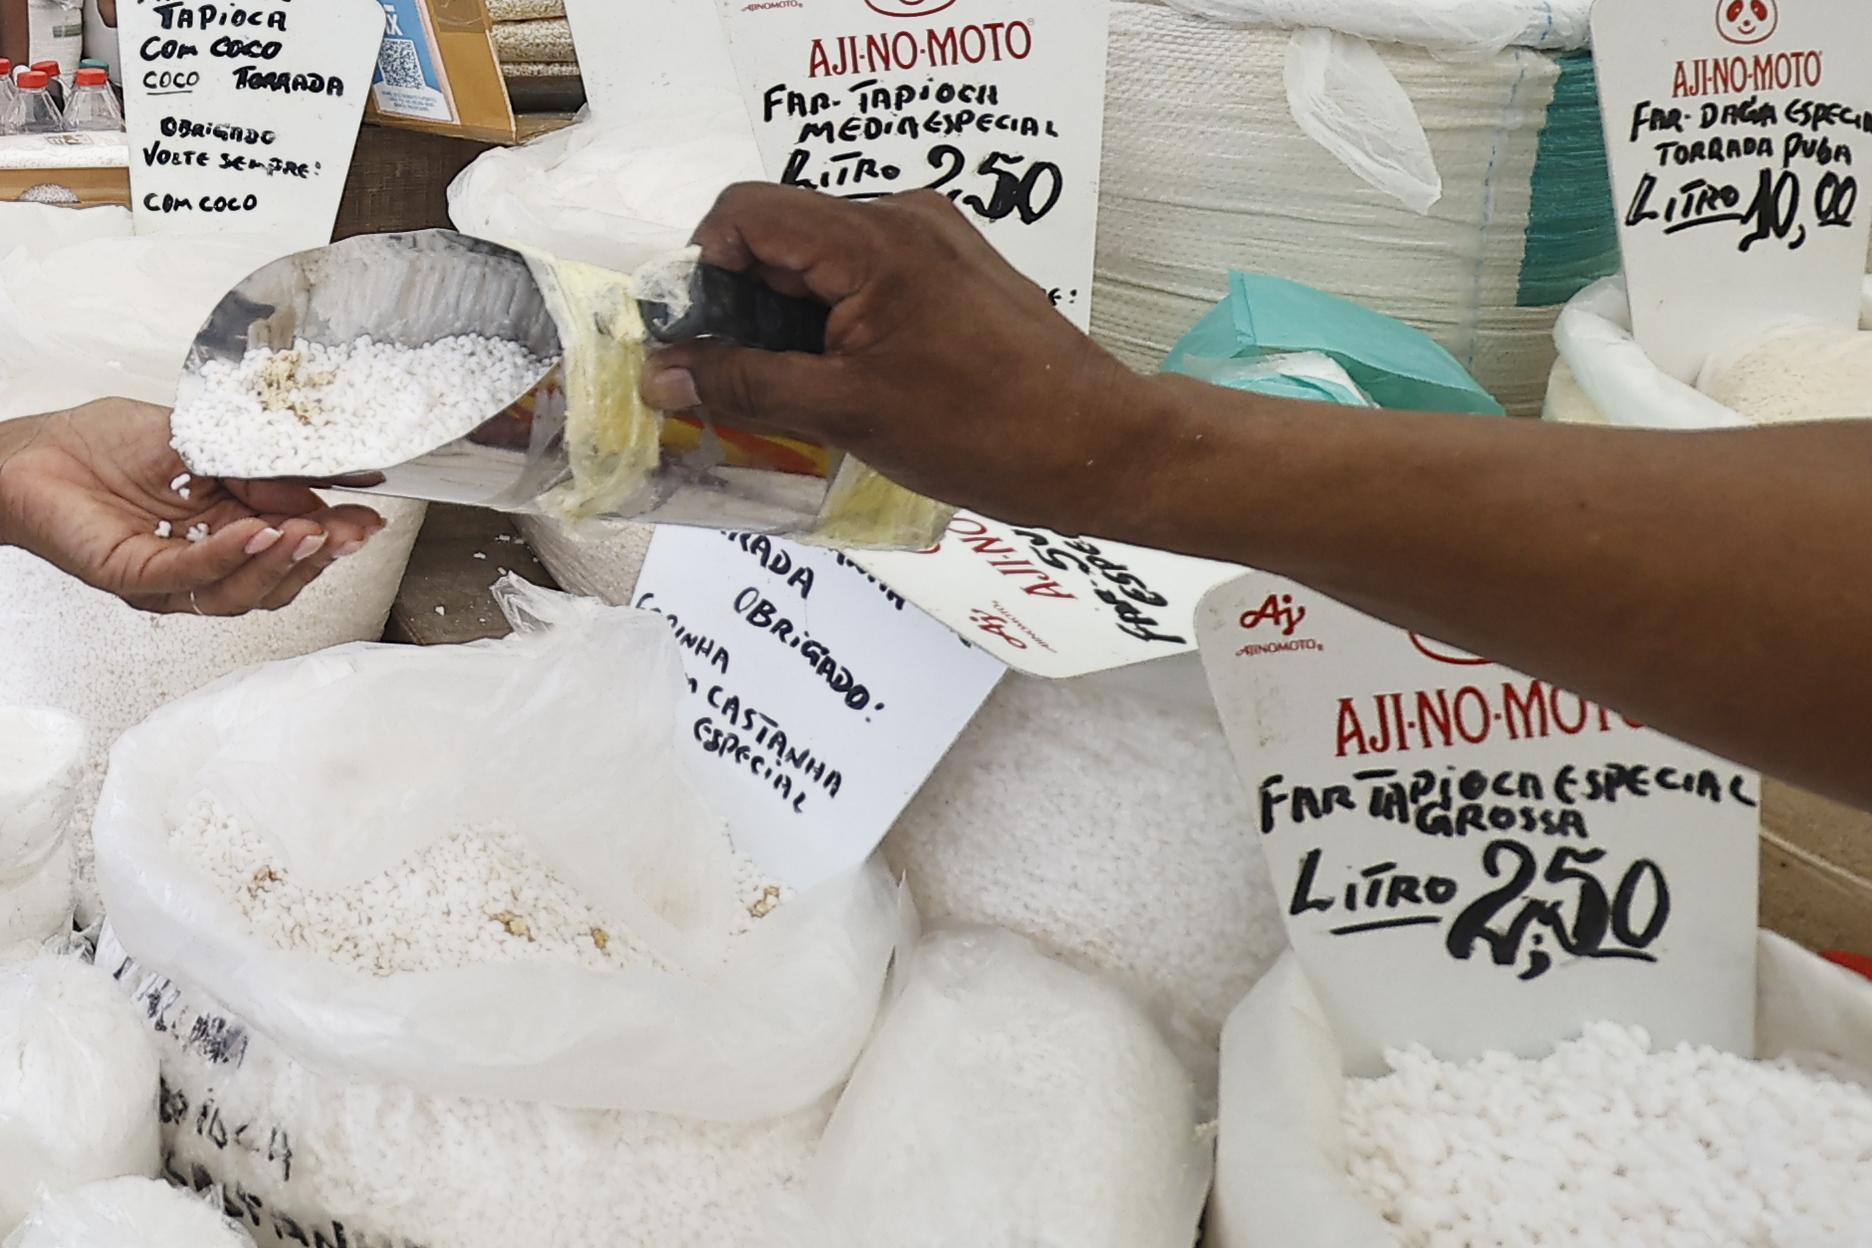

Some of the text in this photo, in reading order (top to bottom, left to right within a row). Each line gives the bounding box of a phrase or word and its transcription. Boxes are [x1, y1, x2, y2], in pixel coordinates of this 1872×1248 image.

[153, 1, 287, 32] TAPIOCA
[139, 35, 283, 61] COM COCO
[142, 70, 201, 90] COCO
[848, 78, 999, 114] TAPIOCA
[159, 116, 278, 145] OBRIGADO
[798, 109, 1060, 145] MEDIA ESPECIAL
[1654, 136, 1774, 168] TORRADA
[143, 193, 258, 214] COM COCO
[1625, 173, 1740, 227] LITRO
[707, 684, 843, 799] CASTANHA
[693, 716, 807, 814] ESPECIAL
[1353, 765, 1544, 825] TAPIOCA
[1554, 763, 1758, 807] ESPECIAL
[1415, 801, 1589, 839] GROSSA
[1289, 848, 1459, 916] LITRO
